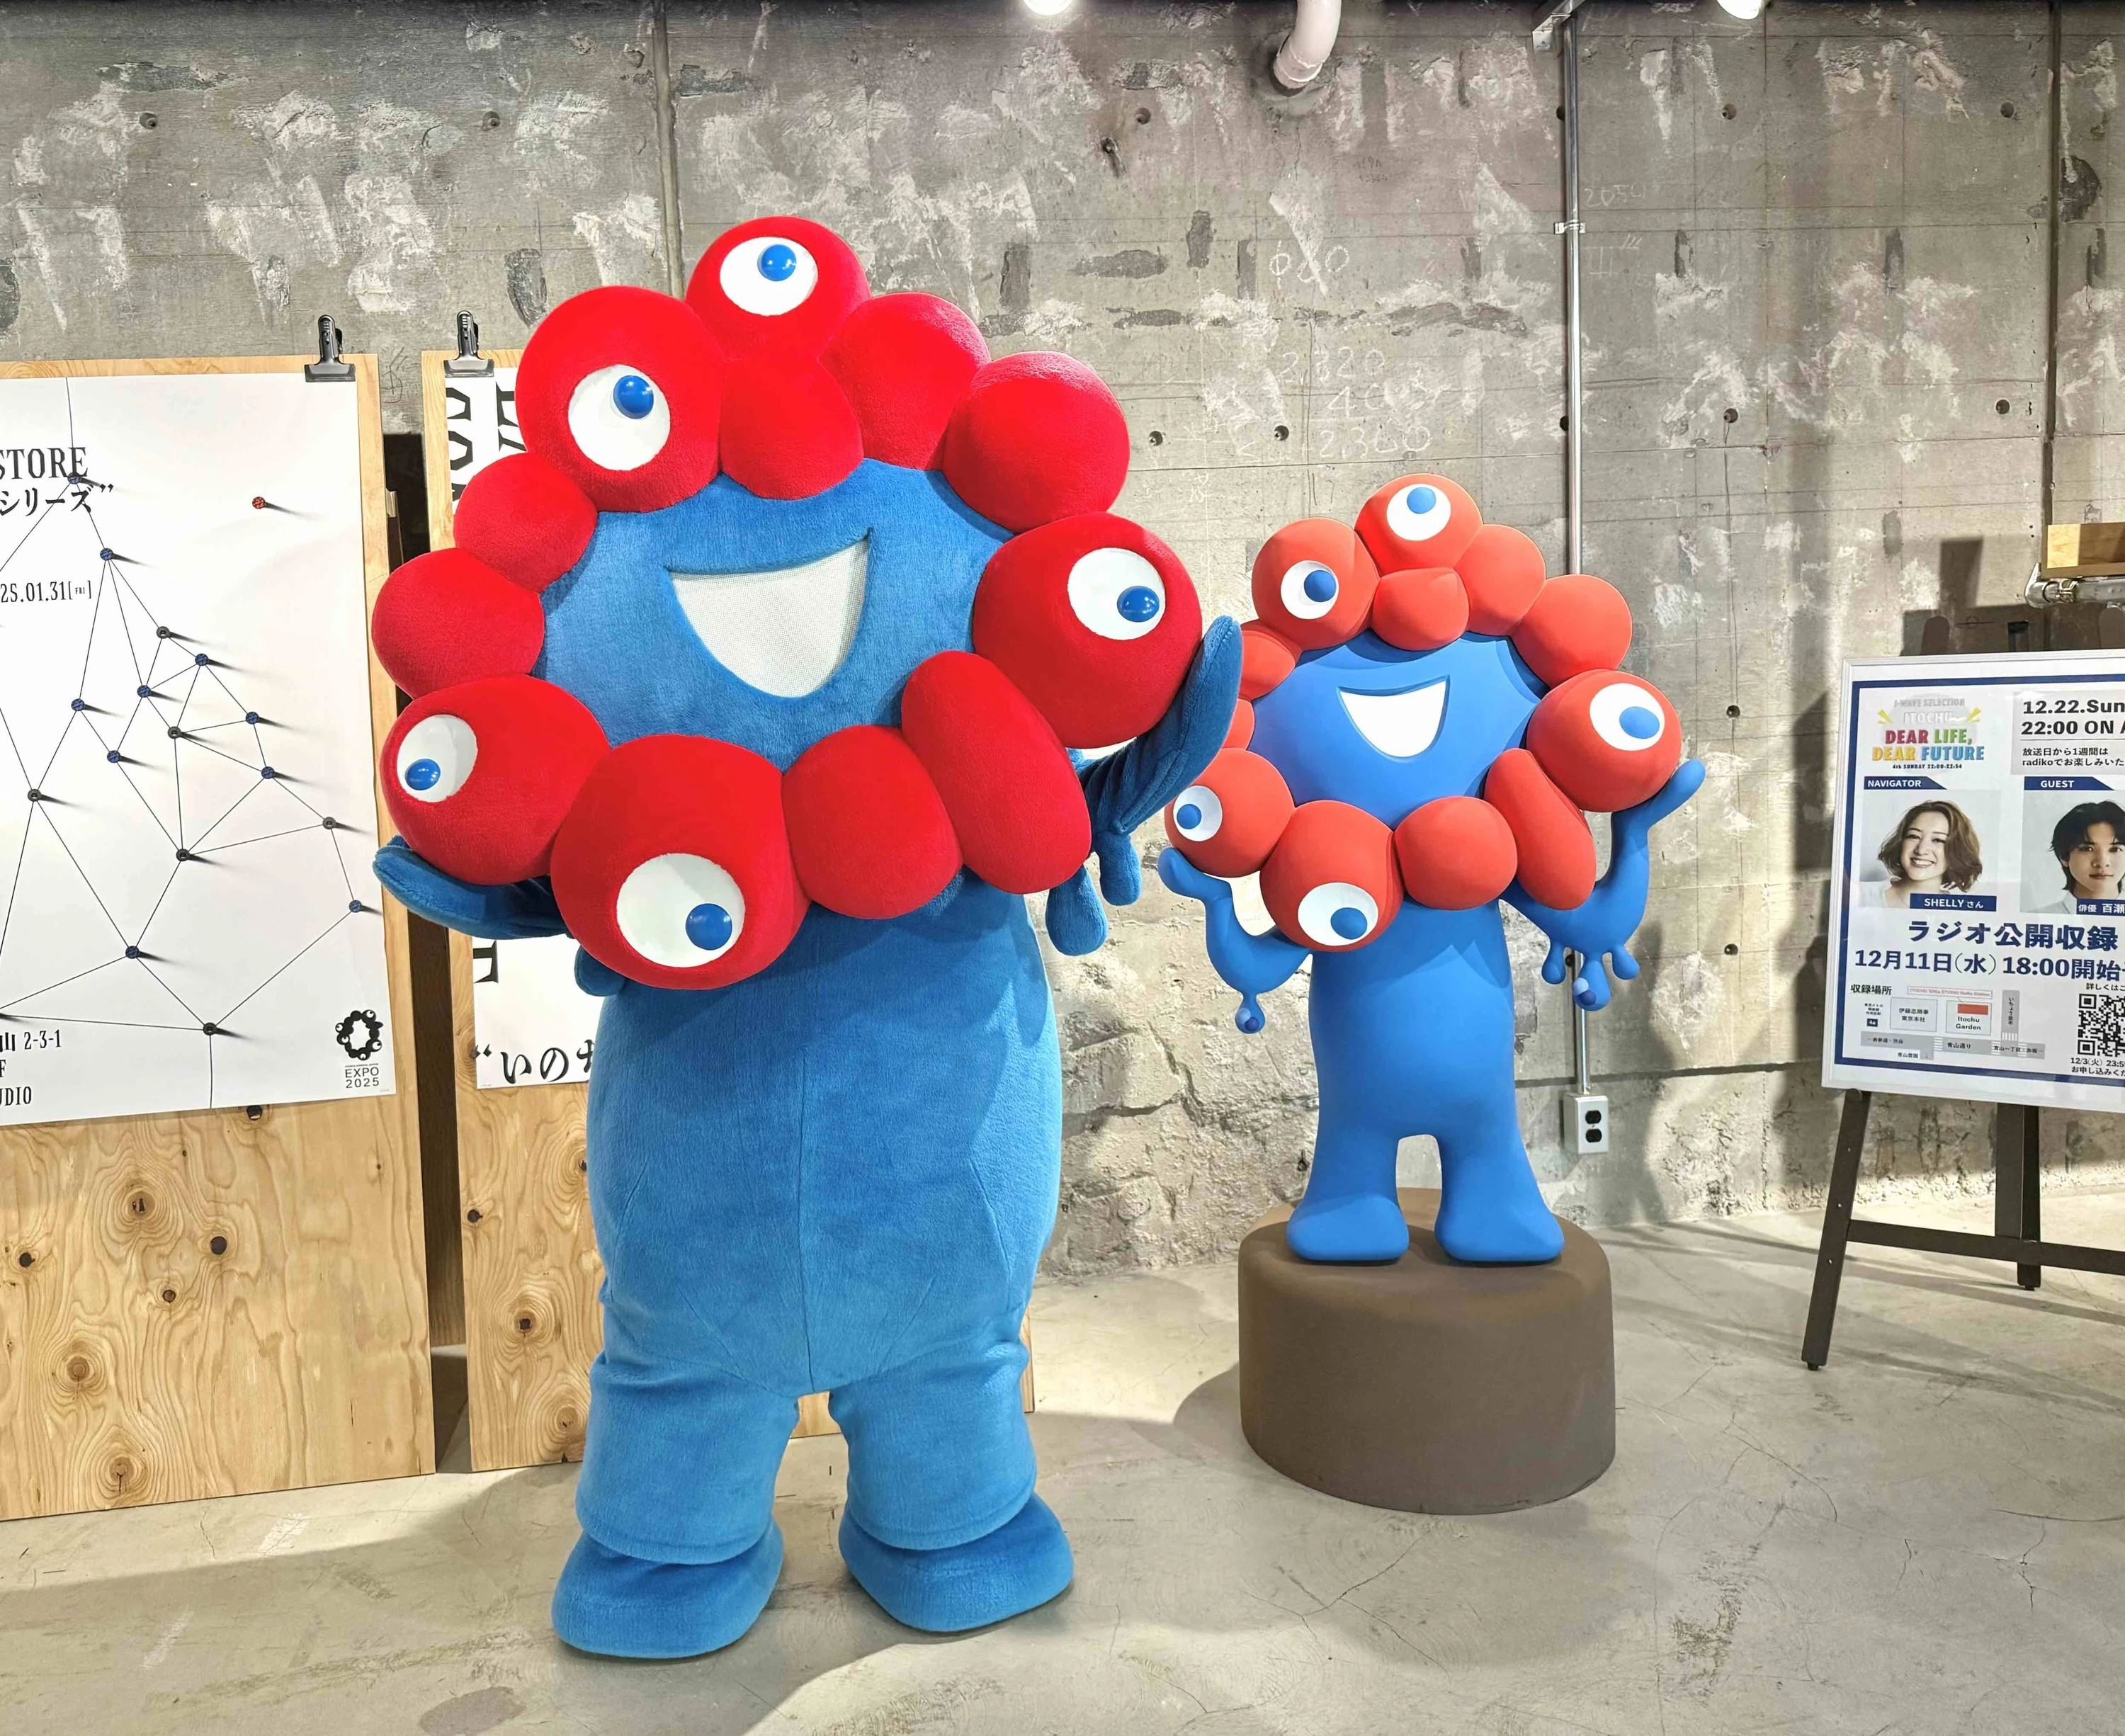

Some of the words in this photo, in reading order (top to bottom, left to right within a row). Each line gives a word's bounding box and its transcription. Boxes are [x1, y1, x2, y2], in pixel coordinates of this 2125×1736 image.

[2021, 720, 2078, 735] 22:00
[2084, 720, 2114, 734] ON
[1885, 730, 1929, 744] DEAR
[1934, 728, 1973, 745] LIFE,
[1871, 746, 1915, 761] DEAR
[1921, 746, 1985, 761] FUTURE
[2022, 747, 2109, 756] 放送日から1週間は
[1867, 779, 1922, 788] NAVIGATOR
[2040, 780, 2075, 788] GUEST
[1924, 898, 1964, 907] SHELLY
[1966, 900, 1983, 909] さん
[1908, 921, 2119, 952] ラジオ公開収録
[2002, 955, 2125, 982] 18:00開始
[1850, 983, 1892, 995] 収録場所
[23, 1029, 61, 1050] 2-3-1
[2106, 1060, 2125, 1068] 23:5
[345, 1067, 379, 1078] EXPO
[346, 1077, 379, 1089] 2025
